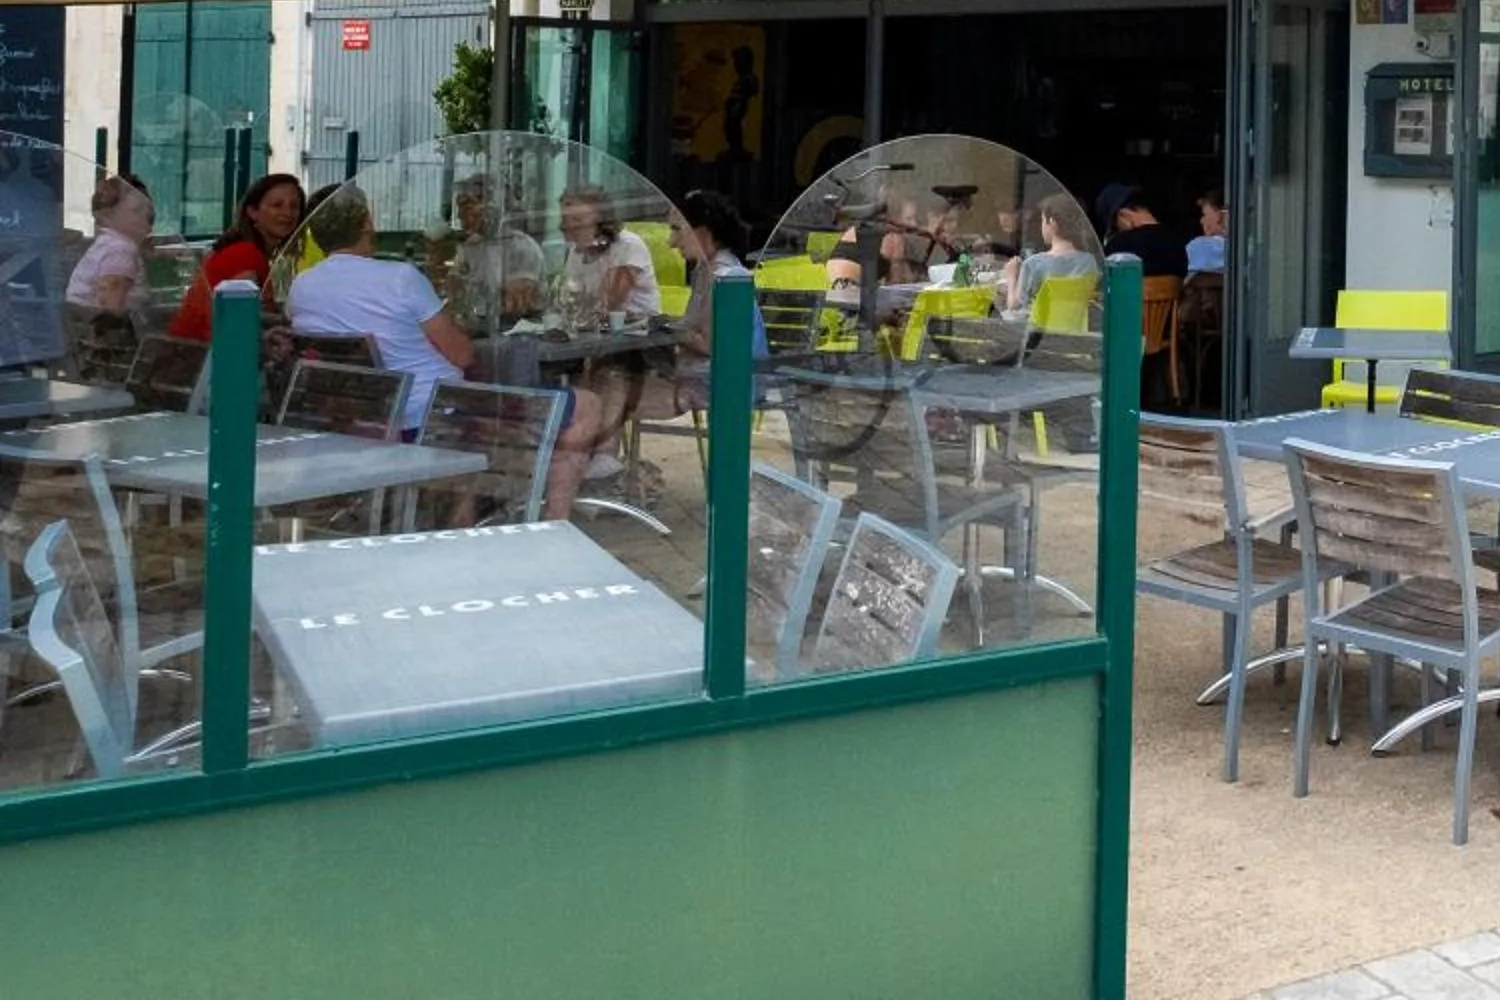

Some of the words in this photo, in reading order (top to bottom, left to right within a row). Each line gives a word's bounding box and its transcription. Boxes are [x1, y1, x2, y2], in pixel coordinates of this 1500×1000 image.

[1399, 78, 1454, 91] HOTEL
[300, 613, 360, 630] LE
[383, 583, 639, 619] CLOCHER
